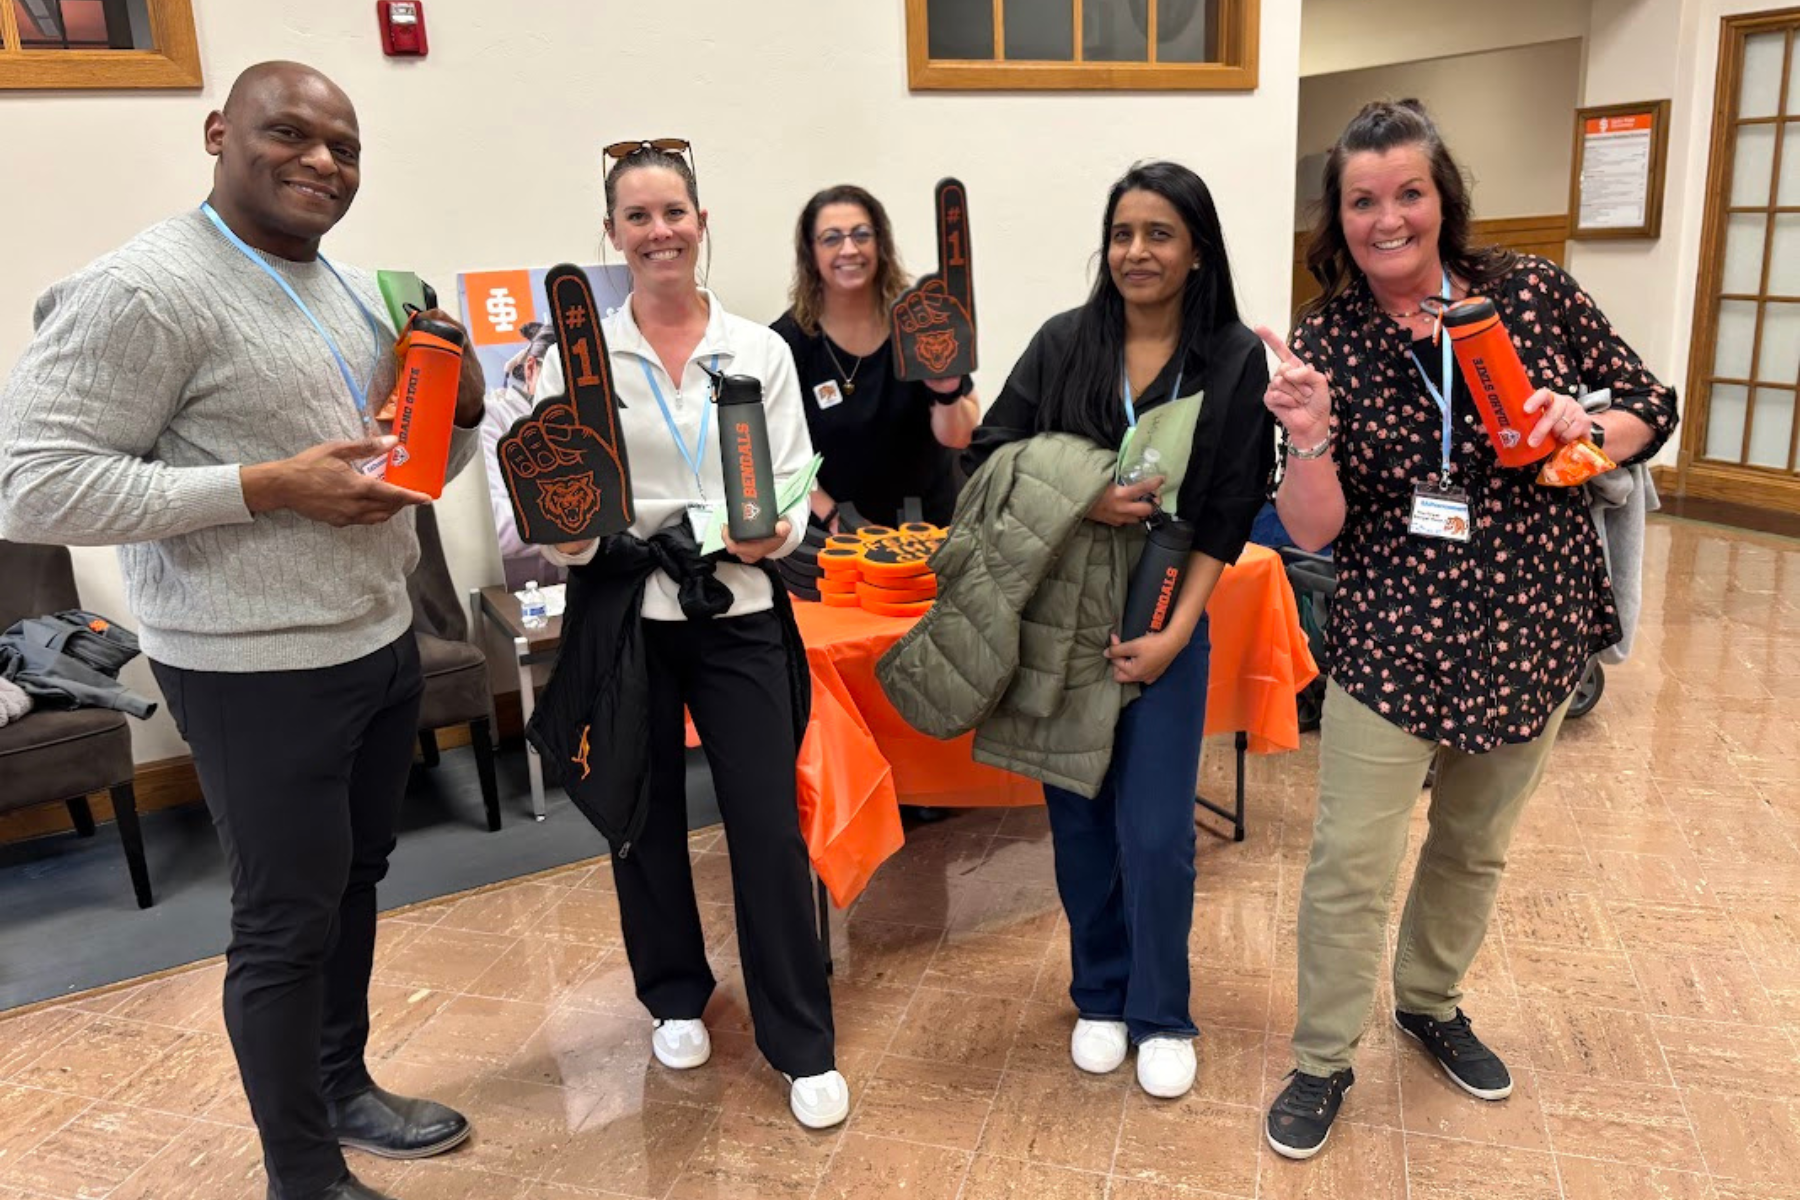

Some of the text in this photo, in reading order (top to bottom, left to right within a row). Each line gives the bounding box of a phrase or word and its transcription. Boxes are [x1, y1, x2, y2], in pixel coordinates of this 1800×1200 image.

[399, 367, 420, 444] IDAHO STATE
[1473, 357, 1511, 427] IDAHO STATE
[735, 422, 758, 498] BENGALS
[1150, 567, 1179, 630] BENGALS
